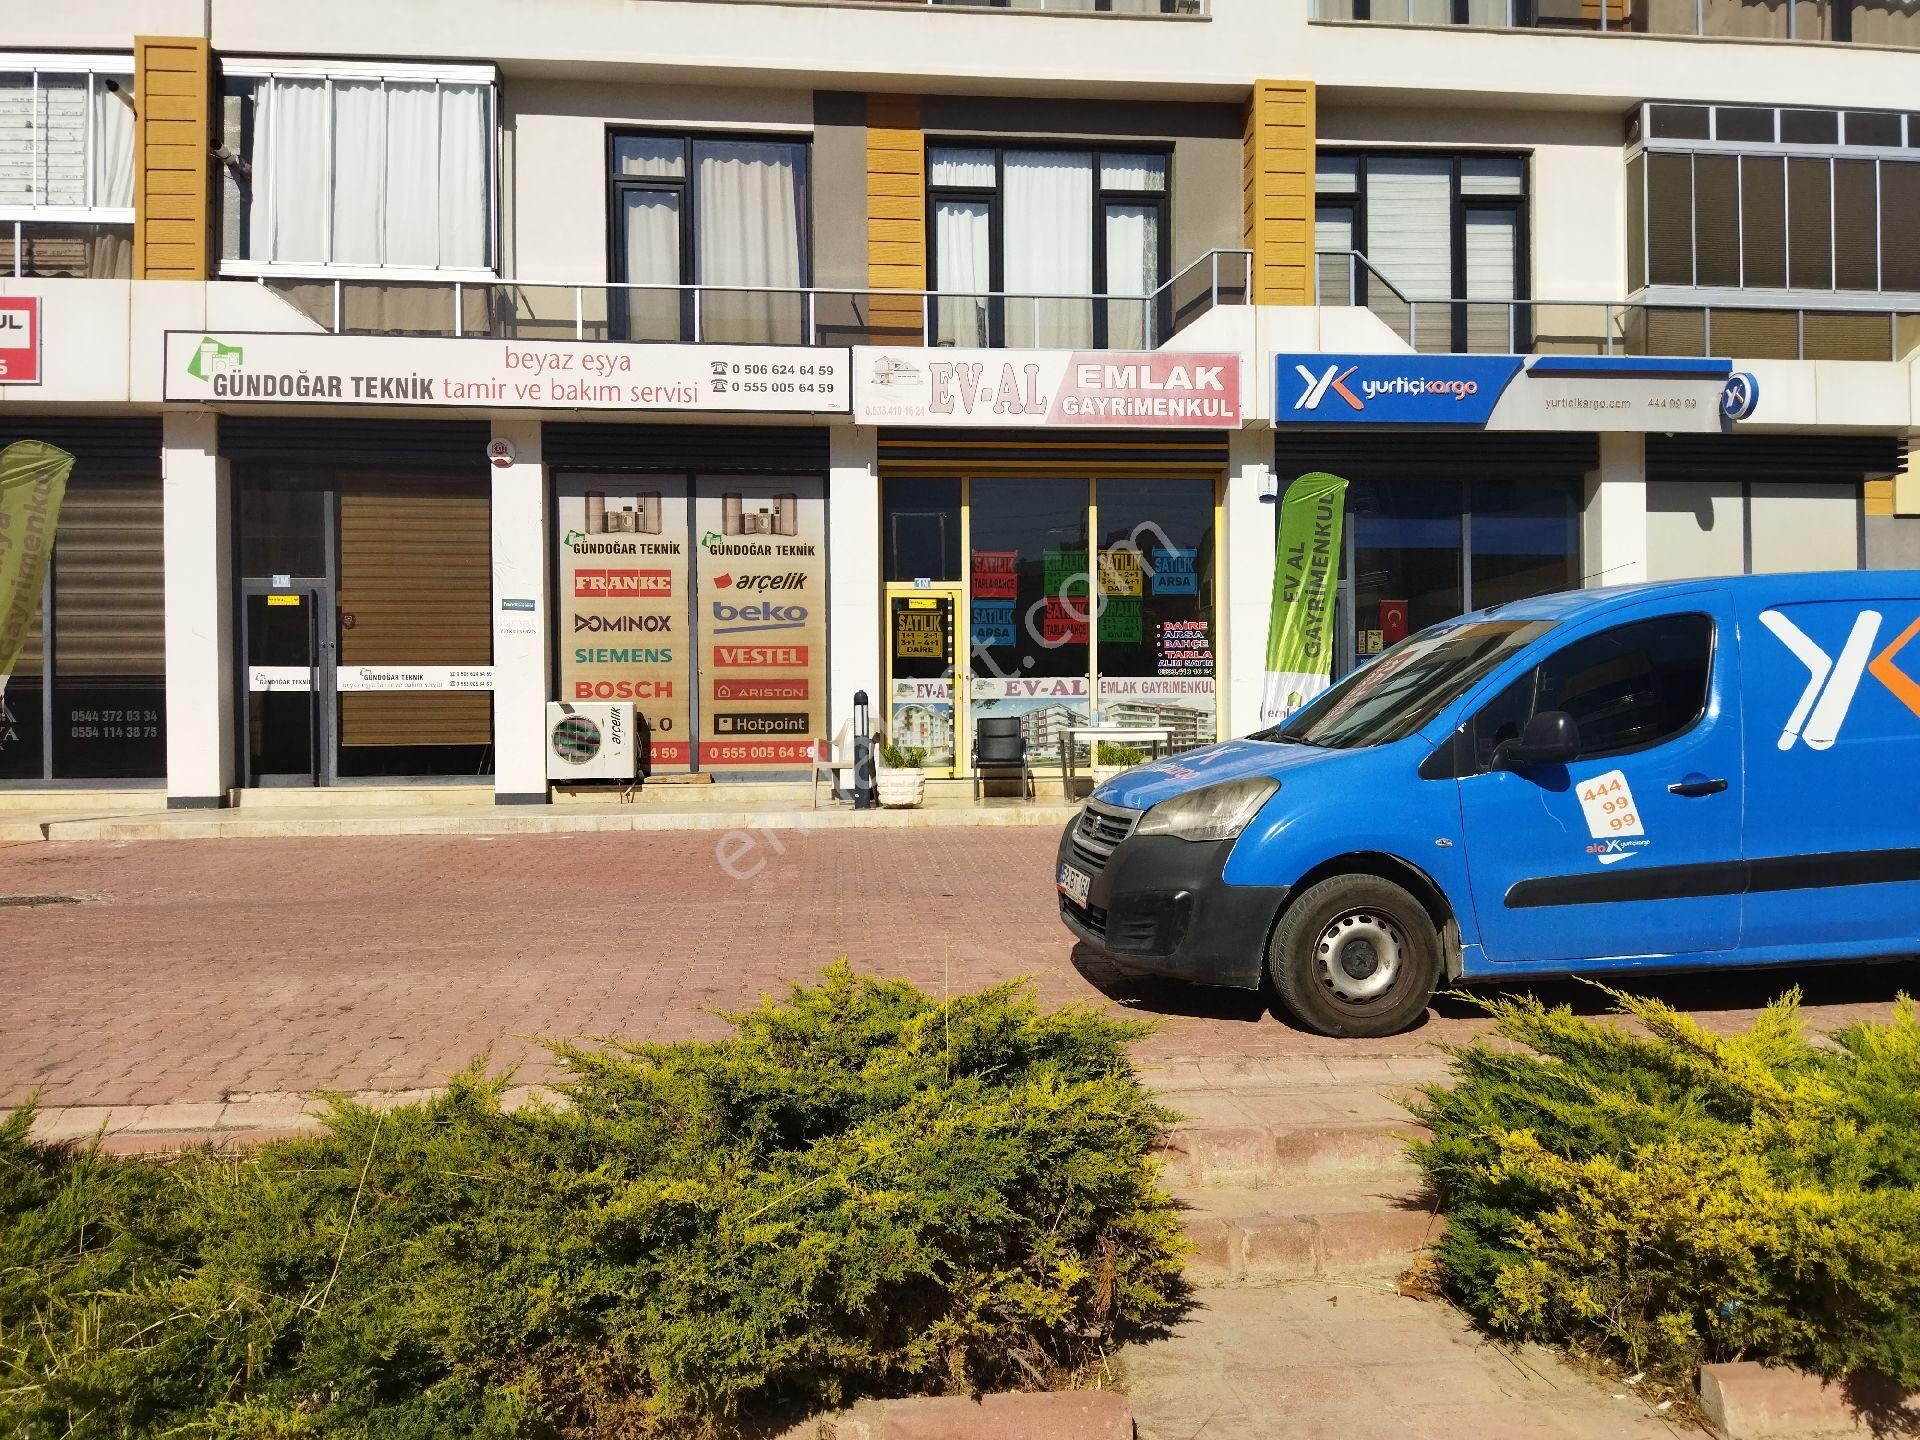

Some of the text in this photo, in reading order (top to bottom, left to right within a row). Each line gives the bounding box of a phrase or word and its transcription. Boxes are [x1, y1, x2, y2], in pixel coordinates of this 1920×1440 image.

[504, 346, 631, 376] beyaz eşya
[732, 365, 834, 376] 0 506 624 64 59
[1076, 364, 1225, 391] EMLAK
[213, 369, 698, 403] GÜNDOĞAR TEKNİK tamir ve bakım servisi
[732, 381, 834, 393] 0 555 005 64 59
[929, 362, 1048, 415] EV-AL
[573, 541, 681, 555] GÜNDOĞAR TEKNİK
[710, 542, 815, 556] GÜNDOĞAR TEKNİK
[974, 557, 1015, 573] SATILIK
[1099, 552, 1141, 570] SATILIK
[1154, 557, 1194, 573] SATILIK
[1284, 542, 1305, 603] EV AL
[575, 576, 671, 590] FRANKE
[736, 572, 808, 593] arçelik
[1158, 577, 1191, 586] ARSA
[713, 602, 808, 622] beko
[973, 608, 1013, 624] SATILIK
[898, 614, 942, 631] SATILIK
[1163, 620, 1208, 630] DAİRE
[977, 628, 1010, 637] ARSA
[1163, 640, 1209, 649] BAHÇE
[575, 648, 672, 663] SIEMENS
[720, 648, 803, 664] VESTEL
[1164, 651, 1213, 659] TARLA
[363, 673, 424, 681] GÜNDOĞAR TEKNİK
[575, 681, 672, 698] BOSCH
[739, 688, 804, 697] ARISTON
[1004, 680, 1088, 697] EV-AL
[1100, 681, 1137, 694] EMLAK
[71, 710, 158, 722] 0544 372 03 34
[71, 727, 99, 738] 0554
[103, 727, 123, 738] 114
[143, 727, 158, 738] 75
[612, 707, 621, 744] arçelik
[737, 718, 805, 733] Hotpoint
[661, 747, 678, 758] 59
[709, 748, 716, 758] 0
[722, 748, 747, 758] 555
[750, 748, 774, 758] 005
[778, 748, 795, 758] 64
[1583, 779, 1621, 801] 444
[1602, 796, 1628, 814] 99
[1609, 814, 1635, 831] 99
[1585, 843, 1606, 853] alo
